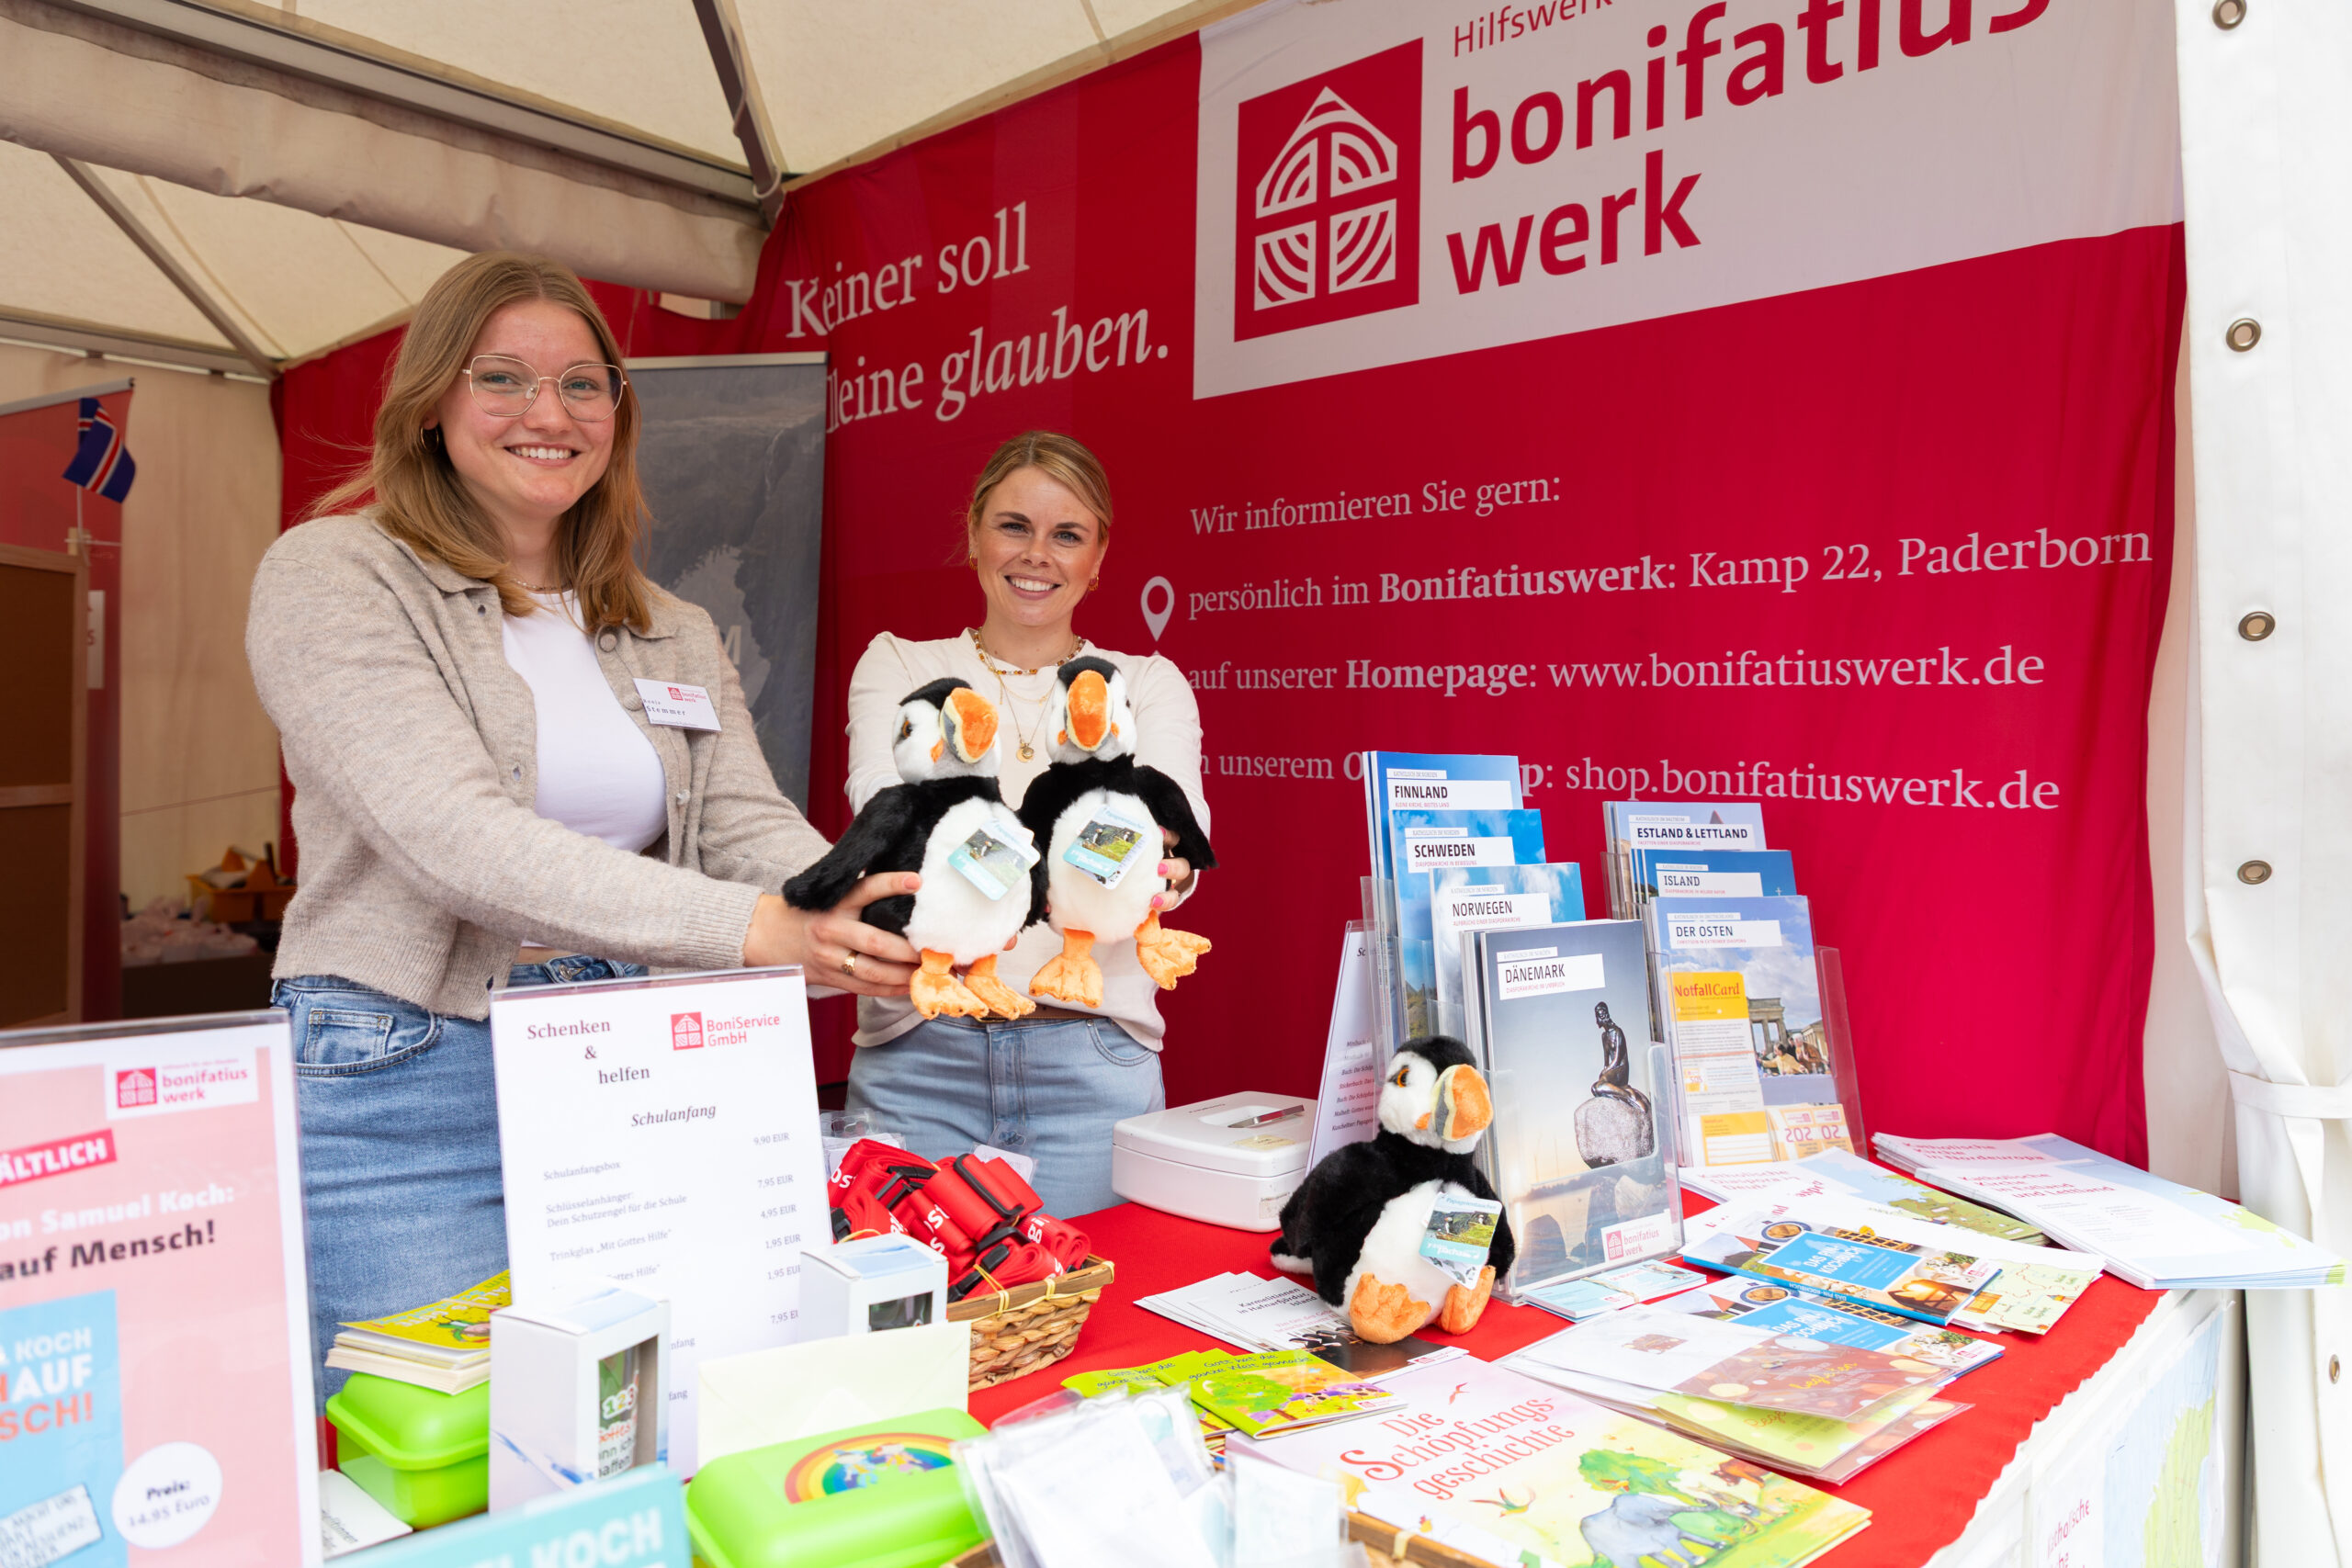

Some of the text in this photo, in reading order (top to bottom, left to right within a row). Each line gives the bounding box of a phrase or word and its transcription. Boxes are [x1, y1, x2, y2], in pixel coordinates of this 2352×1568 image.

[1454, 0, 1613, 57] Hilfswe
[1446, 150, 1702, 296] werk
[786, 201, 1030, 338] Keiner soll
[936, 305, 1169, 422] glauben.
[1191, 477, 1562, 535] Wir informieren Sie gern:
[1188, 527, 2154, 620] persönlich im Bonifatiuswerk: Kamp 22, Paderborn
[1188, 644, 2045, 697] auf unserer Homepage: www.bonifatiuswerk.de
[1218, 754, 1335, 780] unserem
[1395, 785, 1449, 799] FINNLAND
[1566, 756, 2060, 809] shop.bonifatiuswerk.de
[1637, 828, 1748, 839] ESTLAND & LETTLAND
[1414, 843, 1476, 858] SCHWEDEN
[1664, 875, 1701, 886] ISLAND
[1453, 900, 1513, 917] NORWEGEN
[1676, 925, 1735, 937] DER OSTEN
[1505, 964, 1566, 984] DÄNEMARK
[1674, 982, 1740, 997] NotfallCard
[526, 1019, 611, 1040] Schenken
[707, 1013, 780, 1032] BoniService
[707, 1032, 748, 1048] GmbH
[583, 1045, 597, 1060] &
[163, 1066, 248, 1089] bonifatius
[597, 1066, 650, 1085] helfen
[163, 1085, 206, 1104] werk
[630, 1104, 717, 1128] Schulanfang
[752, 1133, 790, 1146] 9,90 EUR
[543, 1161, 621, 1181] Schulanfangsbox
[757, 1174, 794, 1189] 7,95 EUR
[2011, 1182, 2075, 1192] Estland
[2013, 1185, 2115, 1199] und Lettland
[41, 1183, 234, 1233] Samuel Koch:
[547, 1194, 688, 1229] Dein Schutzengel für die Schule
[760, 1203, 797, 1220] 4,95 EUR
[71, 1219, 215, 1268] Mensch!
[765, 1233, 801, 1249] 1,95 EUR
[1623, 1229, 1660, 1245] bonifatius
[548, 1246, 594, 1262] Trinkglas
[616, 1235, 646, 1248] Gottes
[1624, 1243, 1644, 1257] werk
[1804, 1255, 1827, 1269] DAS
[767, 1268, 785, 1280] 1,95
[1238, 1287, 1301, 1308] Karmelitinnen
[1290, 1295, 1317, 1307] Island
[771, 1312, 788, 1325] 7,95
[1771, 1320, 1797, 1334] DAS
[15, 1326, 92, 1363] KOCH
[1107, 1360, 1177, 1378] Gott hat die
[1189, 1368, 1227, 1382] ganze
[1261, 1356, 1314, 1369] gemacht
[1204, 1352, 1278, 1368] Gott hat die
[1378, 1409, 1445, 1439] Die
[1340, 1395, 1554, 1482] Schöpfungs-
[1413, 1421, 1576, 1502] geschichte
[146, 1481, 190, 1500] Preis:
[175, 1495, 210, 1514] Euro
[529, 1506, 663, 1564] KOCH
